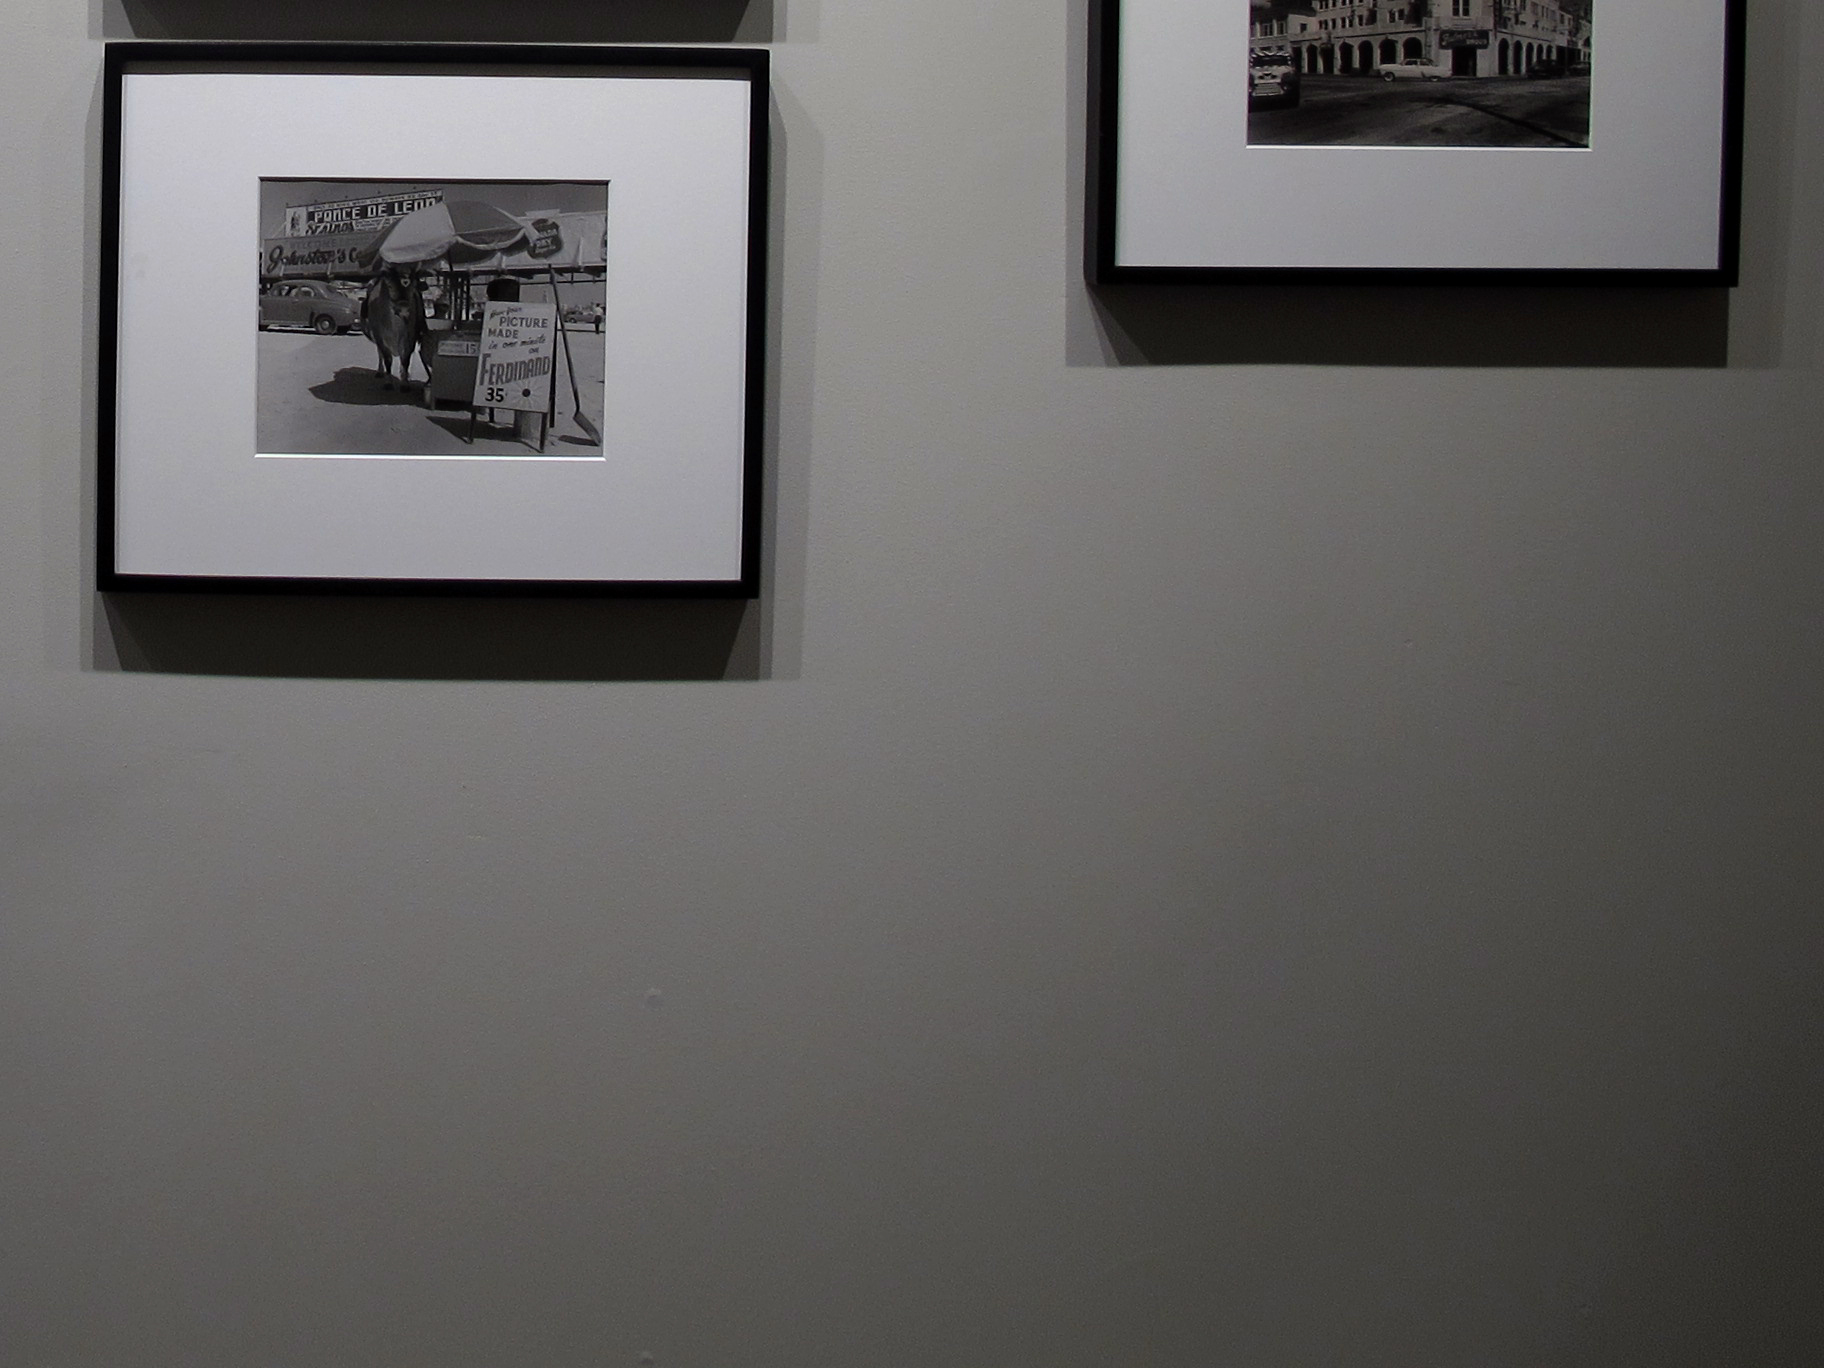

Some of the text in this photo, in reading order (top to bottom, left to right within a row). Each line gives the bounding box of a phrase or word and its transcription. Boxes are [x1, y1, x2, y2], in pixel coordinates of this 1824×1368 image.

[314, 207, 361, 223] PONCE
[367, 204, 387, 217] DE
[499, 317, 548, 329] PICTURE
[488, 328, 518, 338] MADE
[479, 353, 550, 385] FERDINAND
